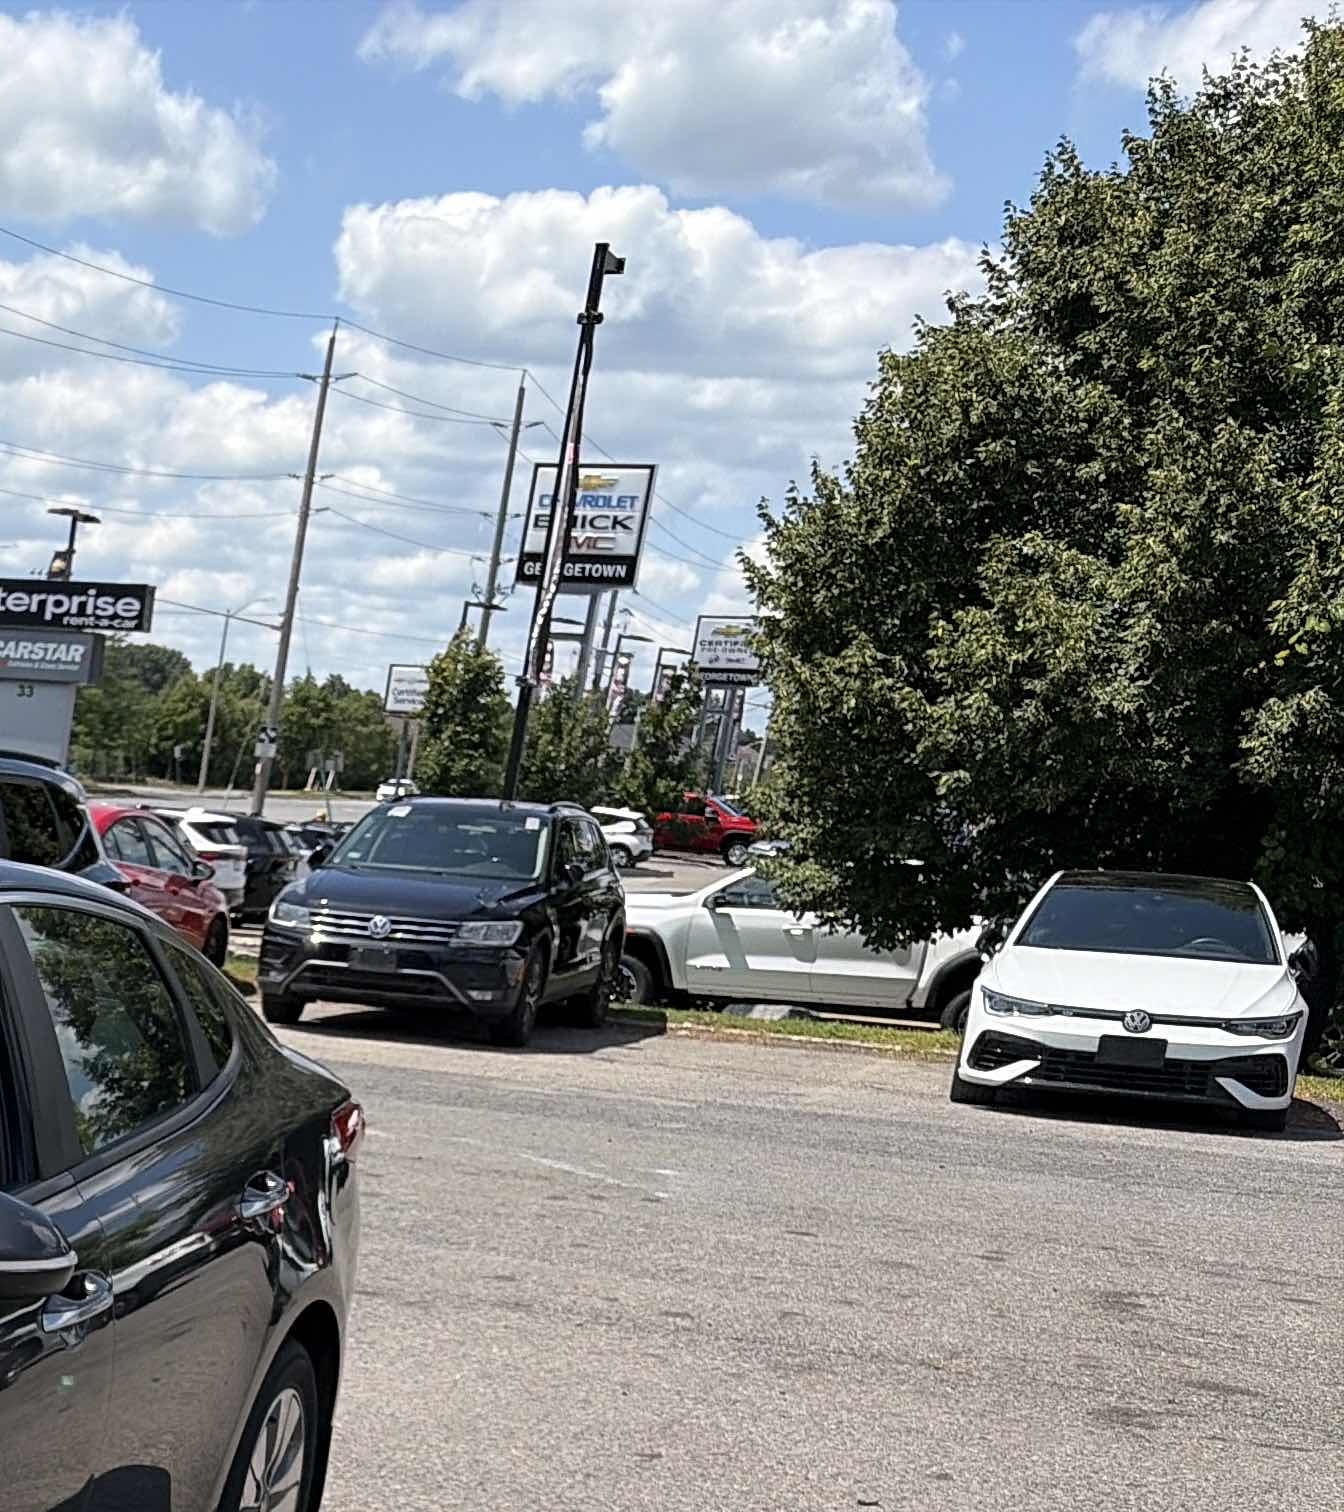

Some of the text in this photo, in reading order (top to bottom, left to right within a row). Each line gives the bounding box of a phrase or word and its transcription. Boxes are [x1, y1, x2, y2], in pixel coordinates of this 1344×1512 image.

[538, 494, 639, 509] CVROLET
[523, 561, 627, 578] GEGETOWN
[62, 615, 139, 630] rent-a-car
[16, 684, 35, 698] 33
